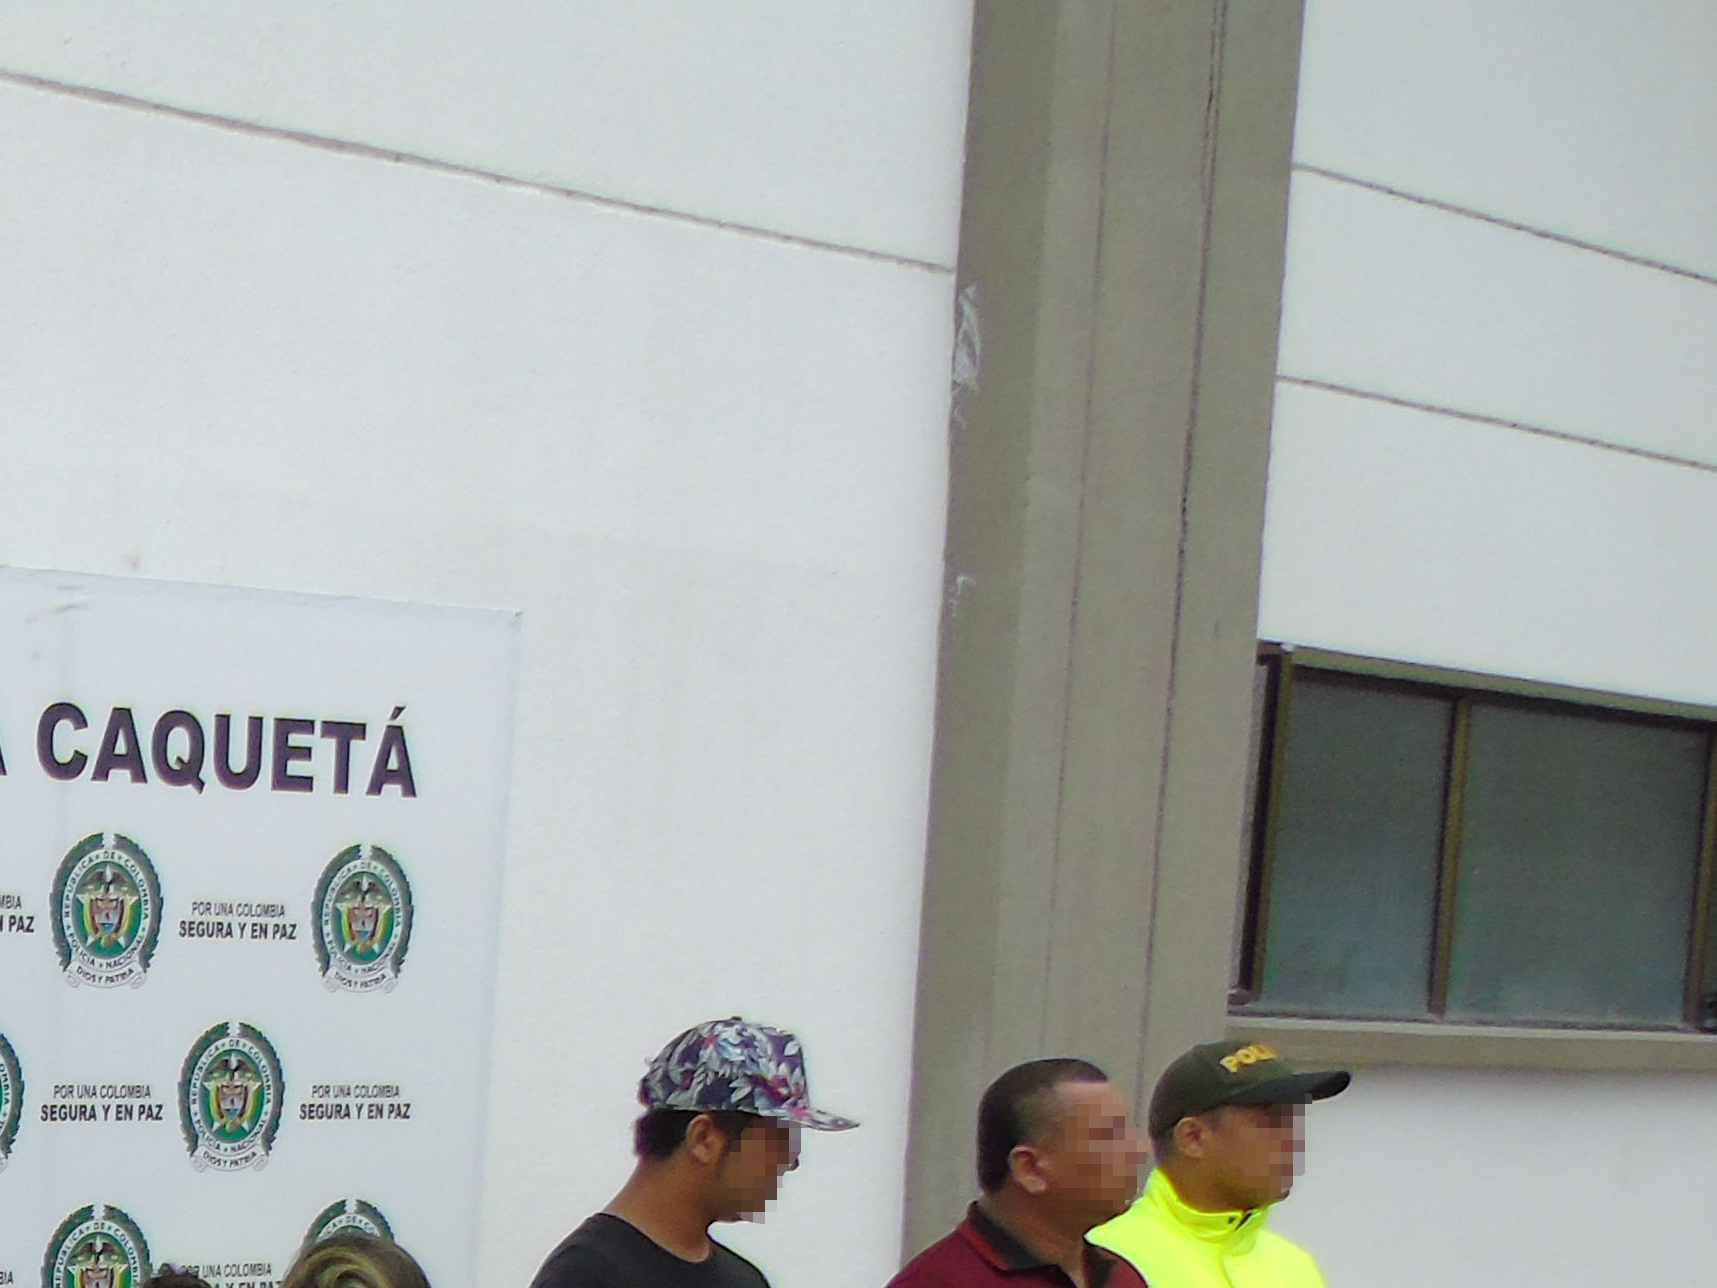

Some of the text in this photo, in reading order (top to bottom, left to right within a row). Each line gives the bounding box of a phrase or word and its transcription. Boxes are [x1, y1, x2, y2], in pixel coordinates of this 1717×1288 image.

[38, 702, 416, 797] CAQUETÁ
[192, 902, 284, 918] POR UNA COLOMBIA
[9, 915, 34, 933] PAZ
[179, 920, 297, 940] SEGURA Y EN PAZ
[54, 1085, 150, 1099] POR UNA COLOMBIA
[41, 1104, 163, 1121] SEGURA Y EN PAZ
[300, 1103, 410, 1120] SEGURA Y EN PAZ
